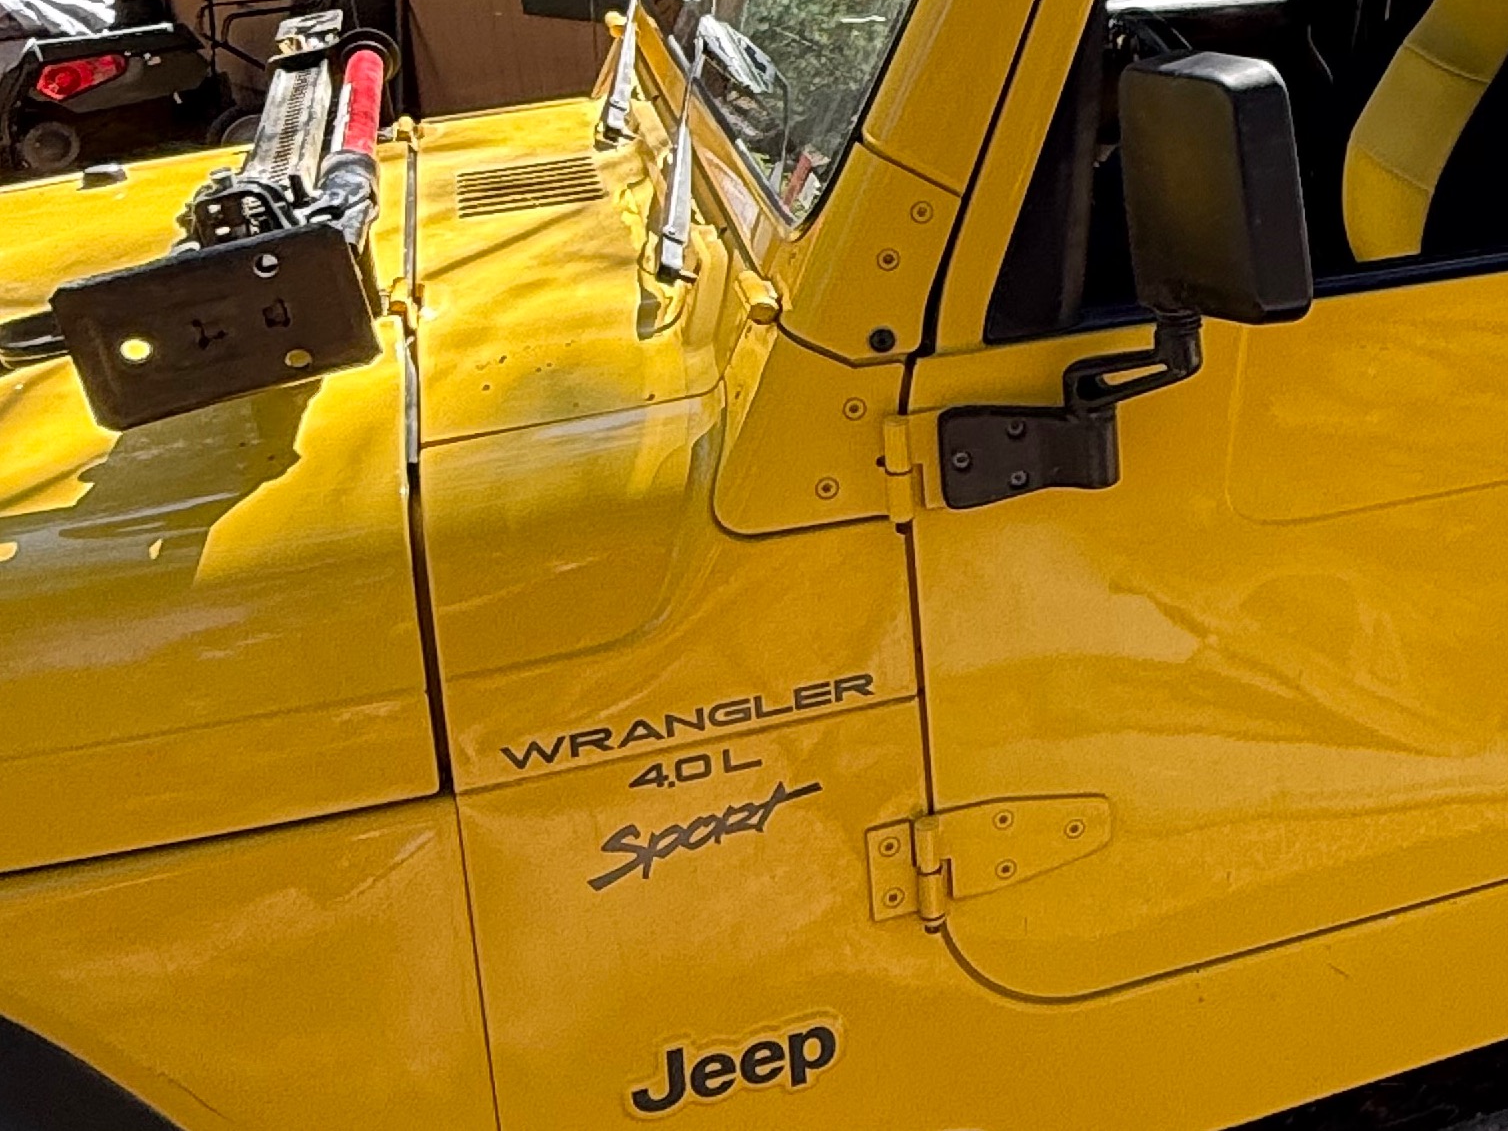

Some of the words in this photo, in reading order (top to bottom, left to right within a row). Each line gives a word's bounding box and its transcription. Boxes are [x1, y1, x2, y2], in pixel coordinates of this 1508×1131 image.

[500, 673, 876, 771] WRANGLER
[586, 780, 824, 892] Sport
[631, 1023, 838, 1115] Jeep
